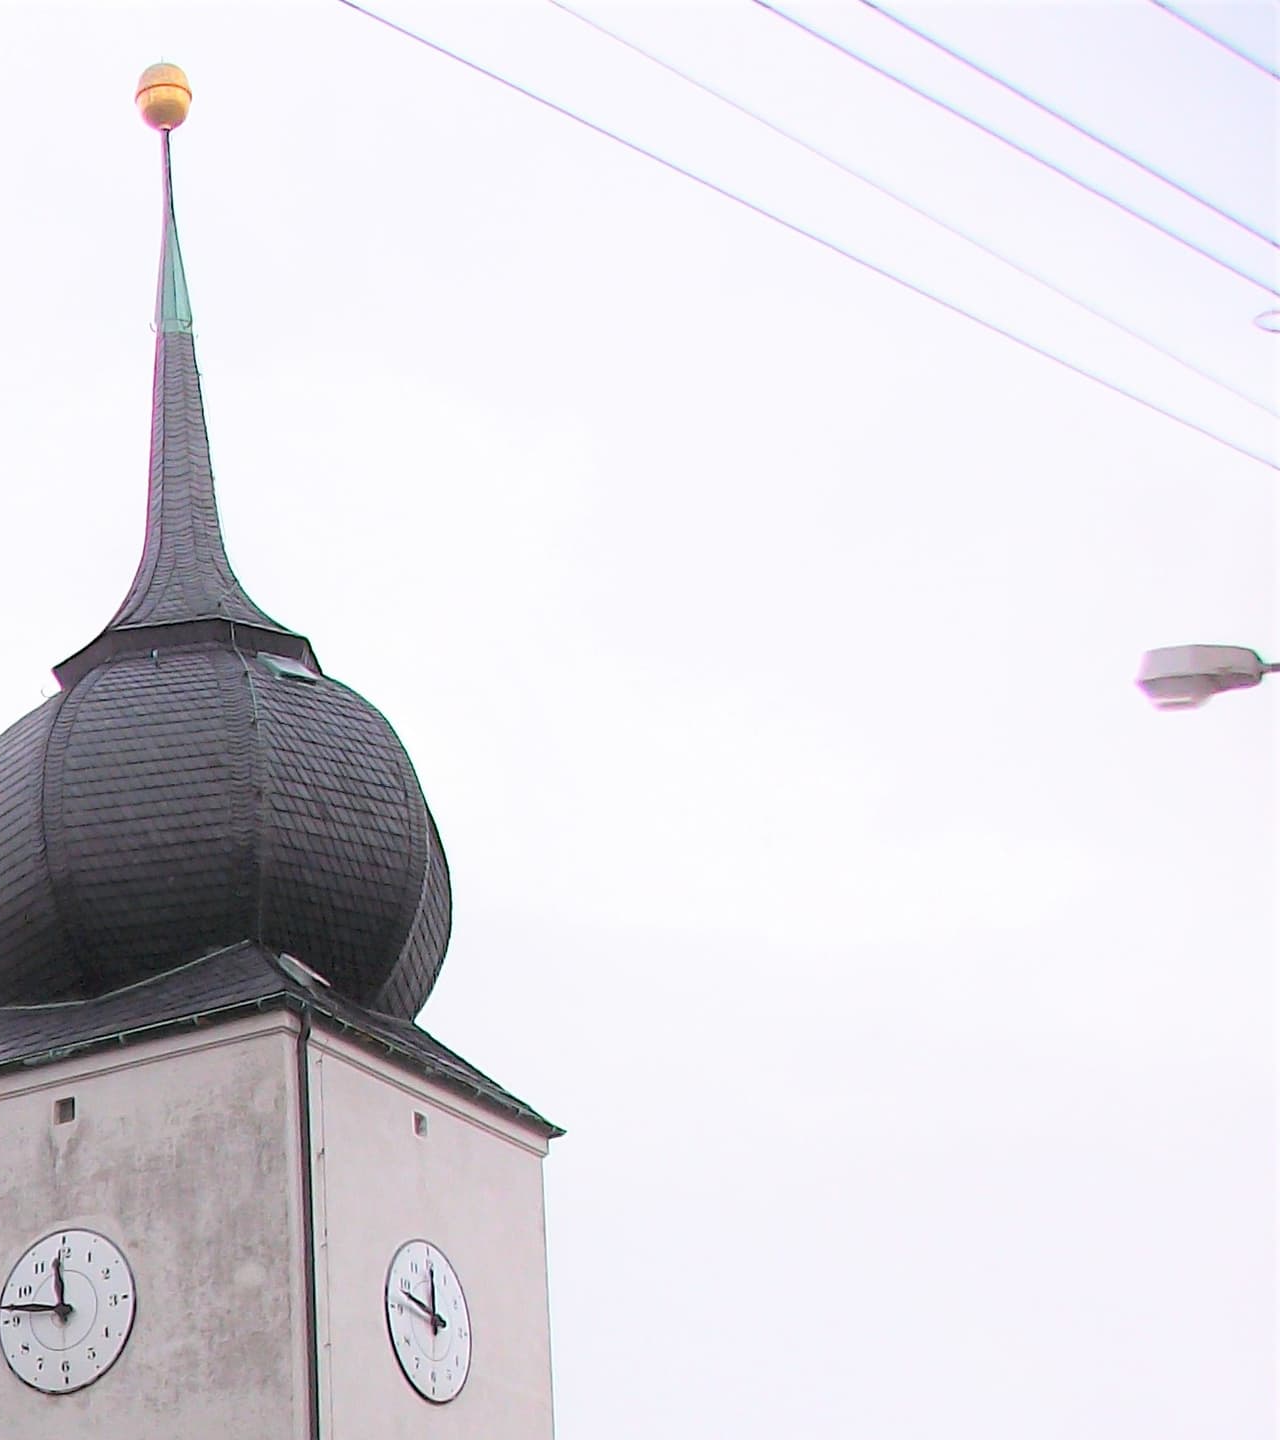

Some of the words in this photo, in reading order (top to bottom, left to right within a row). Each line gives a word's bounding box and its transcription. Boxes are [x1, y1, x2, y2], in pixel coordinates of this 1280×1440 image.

[34, 1261, 45, 1275] 11
[100, 1267, 110, 1280] 2
[18, 1285, 32, 1299] 10
[108, 1294, 118, 1306] 3
[12, 1315, 21, 1328] 9
[87, 1347, 96, 1359] 5
[37, 1357, 44, 1370] 7
[61, 1360, 70, 1372] 6
